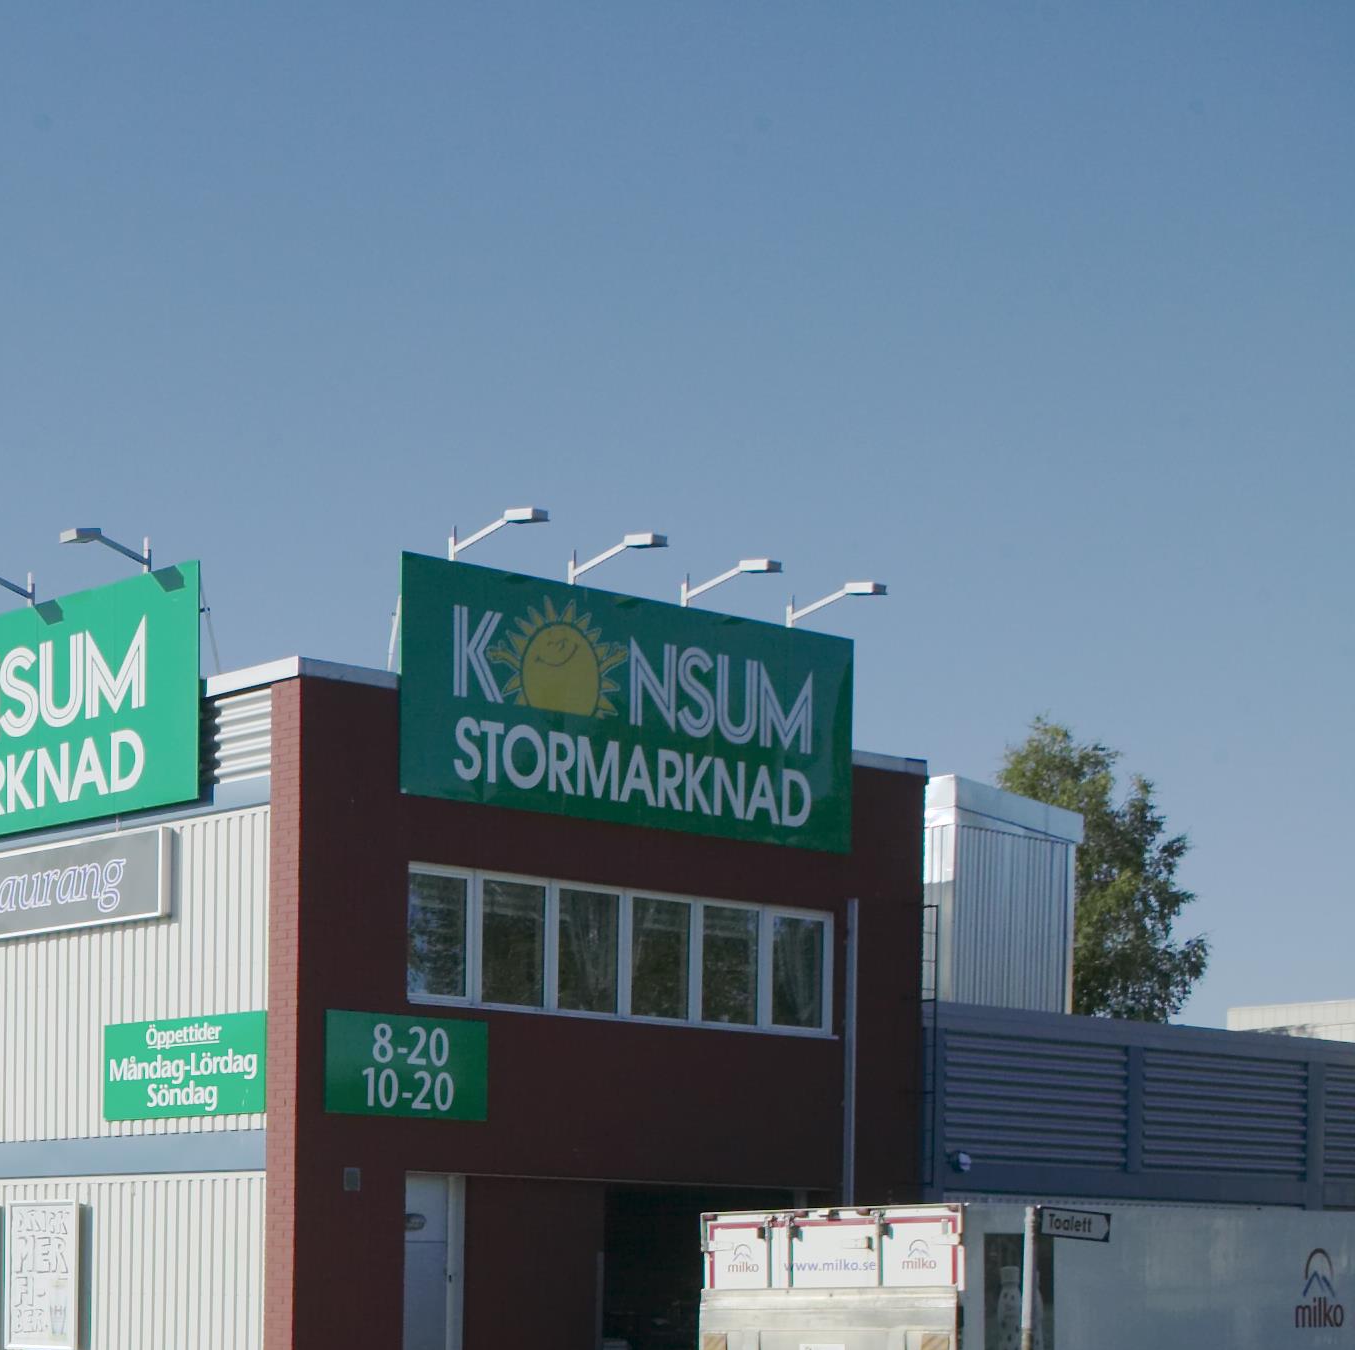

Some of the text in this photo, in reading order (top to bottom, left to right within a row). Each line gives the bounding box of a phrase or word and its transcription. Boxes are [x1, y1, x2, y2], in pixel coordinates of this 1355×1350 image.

[453, 716, 811, 828] STORMARKNAD
[145, 1022, 222, 1049] Öppettider
[372, 1023, 450, 1067] 8-20
[109, 1047, 258, 1085] Måndag-Lördag
[146, 1080, 218, 1111] Söndag
[362, 1067, 455, 1111] 10-20
[1048, 1213, 1093, 1233] Toalett
[14, 1235, 69, 1274] MER
[727, 1262, 760, 1273] milko
[901, 1258, 937, 1270] milko
[1295, 1297, 1345, 1328] milko
